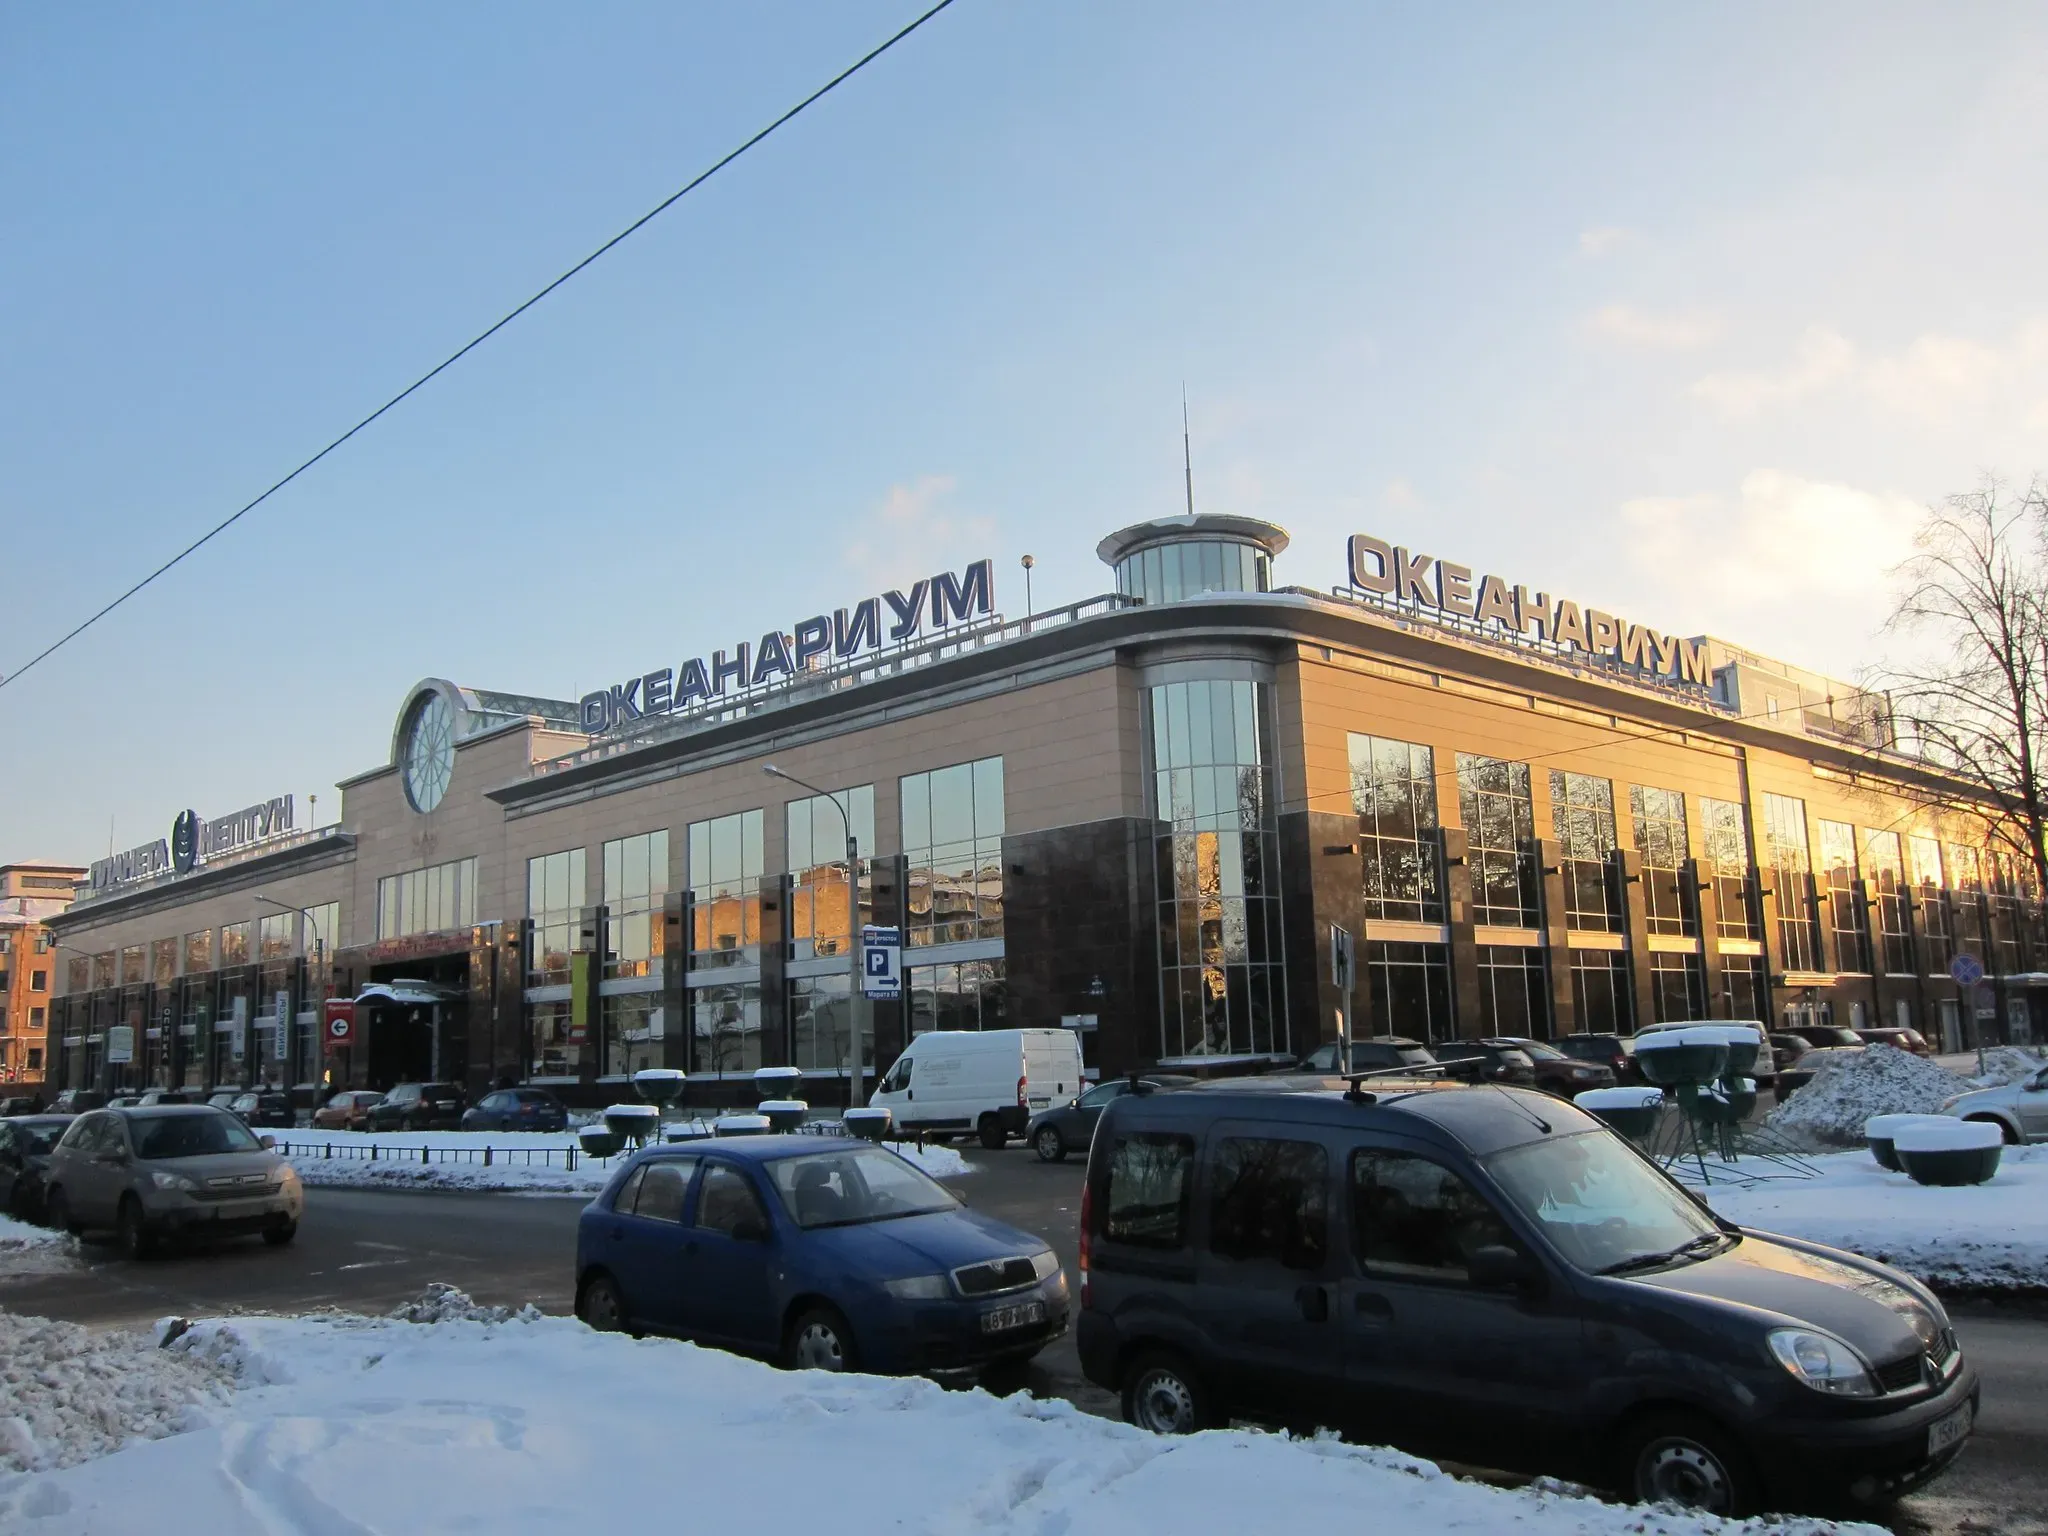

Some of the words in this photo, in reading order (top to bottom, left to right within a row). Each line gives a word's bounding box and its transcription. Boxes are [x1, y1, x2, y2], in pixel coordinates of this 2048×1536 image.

[579, 558, 996, 735] ОКЕАНАРИУМ
[1347, 533, 1713, 688] ОКЕАНАРИУМ
[91, 838, 170, 890] ПЛАНЕТА
[200, 794, 294, 855] НЕПТУН
[162, 1008, 171, 1059] ОПТИКА
[277, 998, 287, 1057] АВИАКАССЫ
